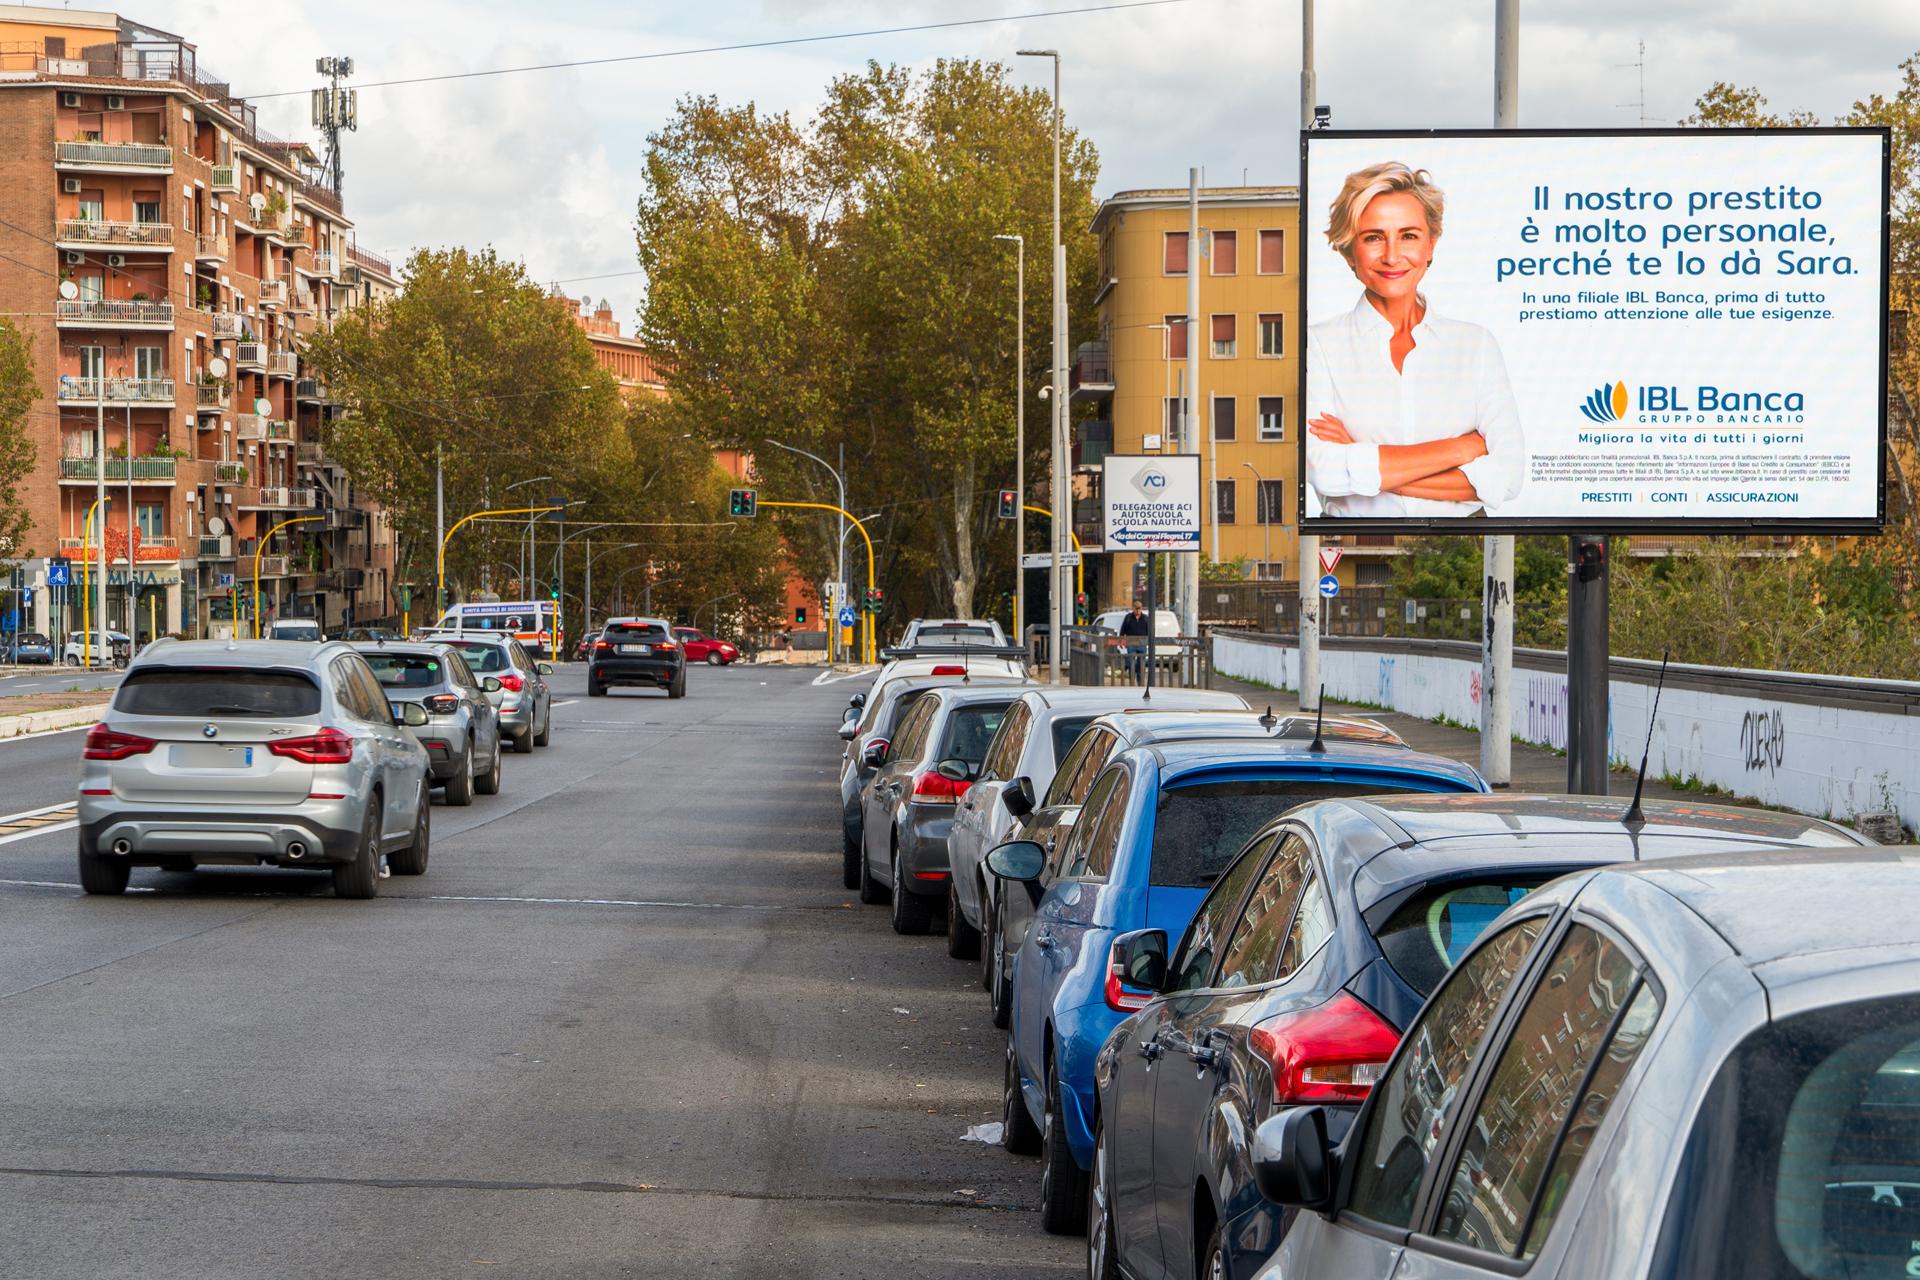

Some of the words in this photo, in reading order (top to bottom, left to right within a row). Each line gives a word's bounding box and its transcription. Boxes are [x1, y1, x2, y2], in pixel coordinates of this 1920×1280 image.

[1534, 186, 1549, 210] Il
[1565, 187, 1673, 211] nostro
[1688, 185, 1822, 216] prestito
[1520, 216, 1540, 243] è
[1555, 218, 1647, 243] molto
[1662, 217, 1835, 249] personale,
[1497, 249, 1612, 282] perché
[1626, 252, 1662, 276] te
[1677, 250, 1705, 276] lo
[1720, 248, 1761, 275] dà
[1776, 250, 1858, 275] Sara.
[1522, 292, 1536, 304] In
[1542, 294, 1571, 304] una
[1577, 291, 1620, 304] filiale
[1626, 291, 1649, 303] IBL
[1655, 291, 1708, 305] Banca,
[1715, 291, 1758, 306] prima
[1764, 291, 1779, 303] di
[1785, 292, 1826, 303] tutto
[1519, 308, 1598, 323] prestiamo
[1604, 307, 1689, 320] attenzione
[1695, 307, 1723, 320] alle
[1729, 308, 1756, 319] tue
[1761, 307, 1834, 322] esigenze.
[1639, 386, 1689, 411] IBL
[1698, 386, 1804, 412] Banca
[1638, 414, 1705, 423] GRUPPO
[1716, 414, 1804, 423] BANCARIO
[1578, 433, 1634, 445] Migliora
[1640, 433, 1653, 443] la
[1660, 433, 1687, 443] vita
[1694, 433, 1706, 443] di
[1713, 433, 1745, 443] tutti
[1752, 433, 1756, 443] i
[1762, 433, 1804, 445] giorni
[1144, 476, 1166, 487] ACI
[1582, 492, 1632, 502] PRESTITI
[1651, 492, 1688, 502] CONTI
[1706, 493, 1798, 502] ASSICURAZIONI
